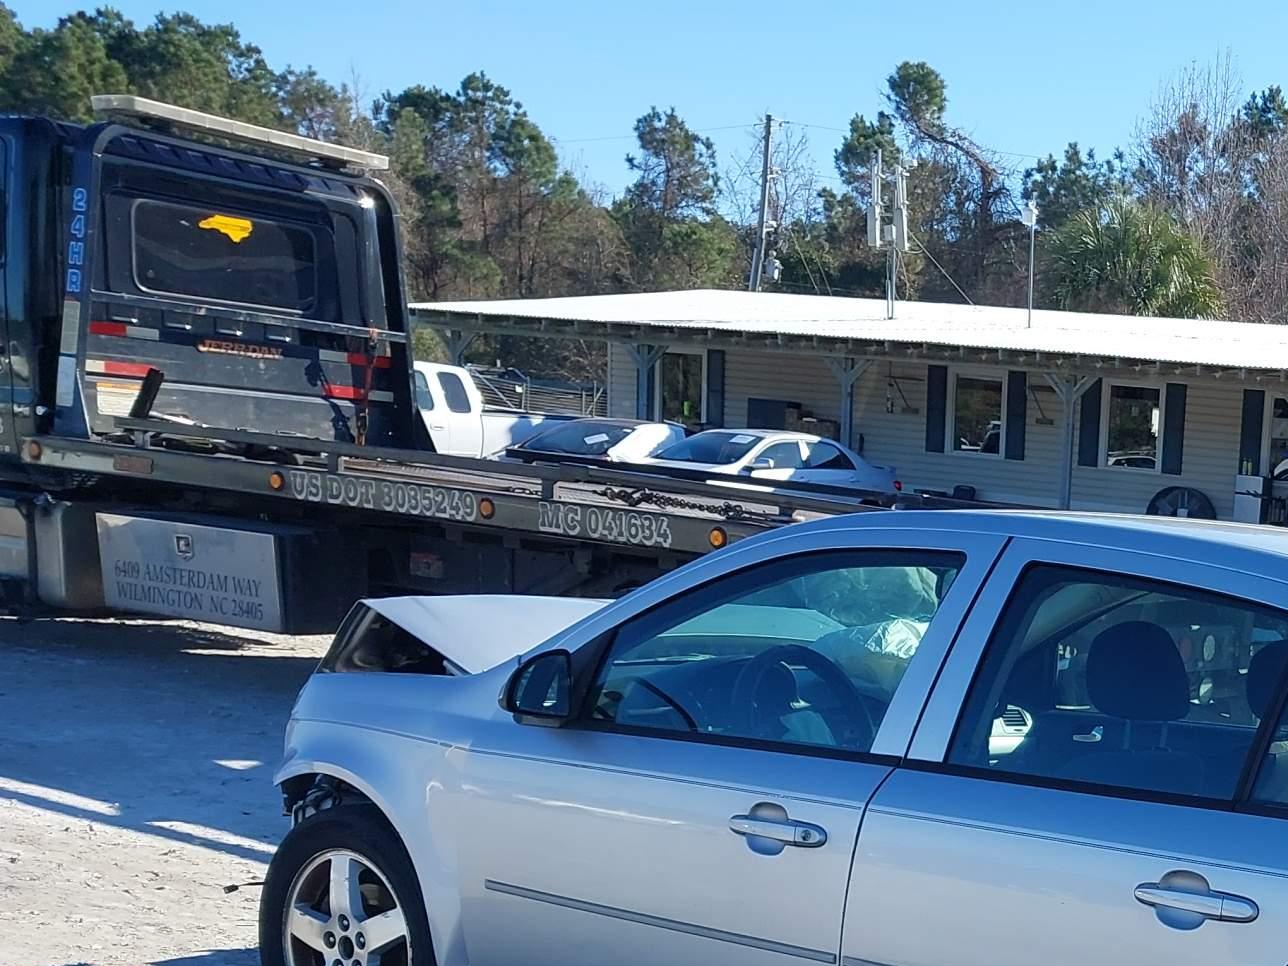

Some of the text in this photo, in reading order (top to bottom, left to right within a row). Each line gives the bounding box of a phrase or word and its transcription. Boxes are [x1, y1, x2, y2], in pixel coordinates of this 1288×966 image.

[66, 187, 87, 292] 24HR
[290, 470, 477, 522] US DOT 3035249
[538, 502, 672, 548] MC 041634
[114, 559, 262, 598] 6409 AMSTERDAM WAY
[116, 582, 264, 622] WILMINGTON NC 28405
